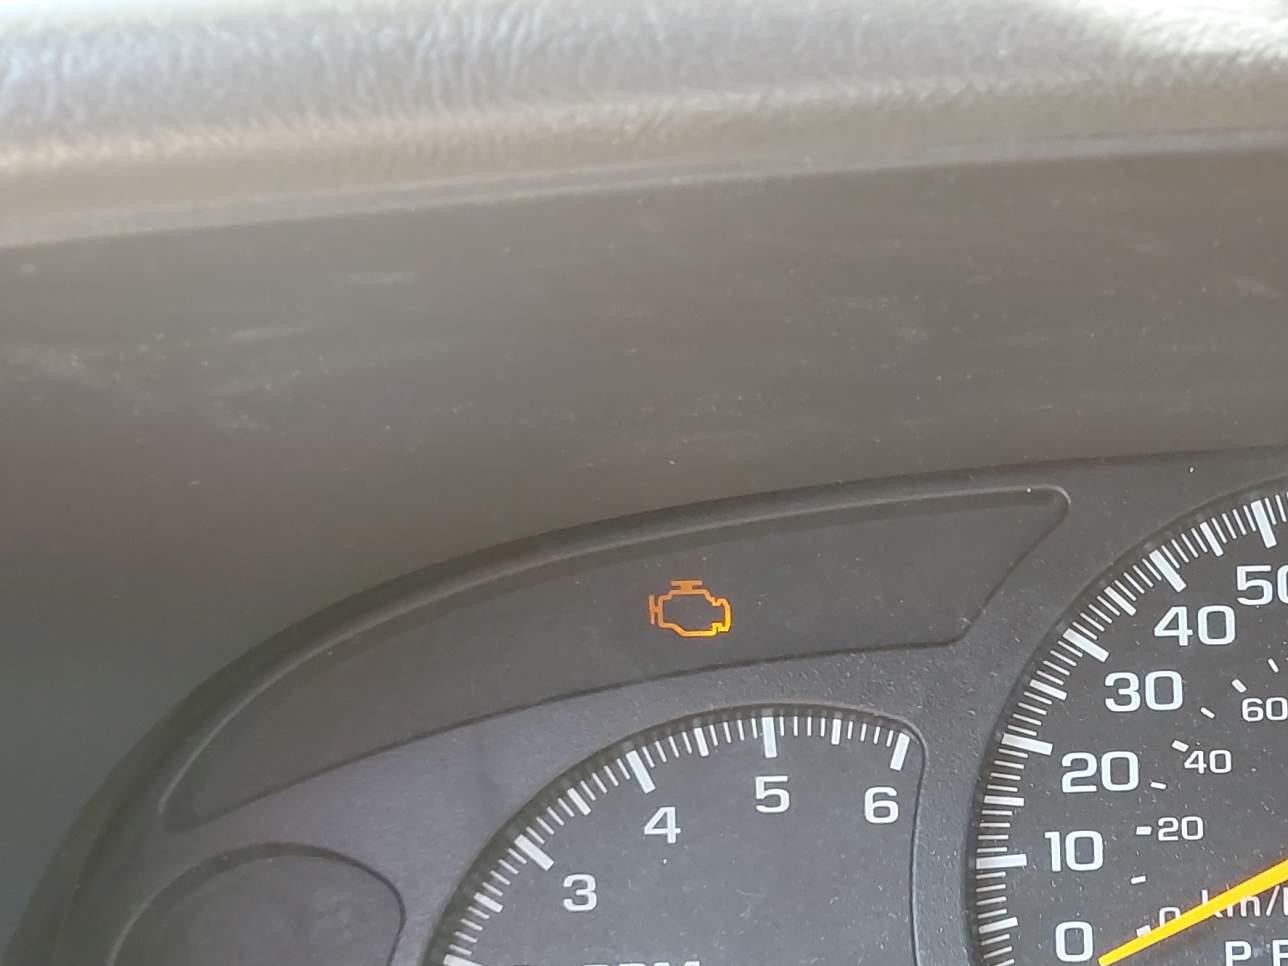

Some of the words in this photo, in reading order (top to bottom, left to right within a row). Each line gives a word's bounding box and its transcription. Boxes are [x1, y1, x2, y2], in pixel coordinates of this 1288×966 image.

[1154, 605, 1236, 646] 40
[1104, 670, 1183, 712] 30
[1241, 696, 1288, 722] 60
[1061, 751, 1139, 793] 20
[1184, 749, 1232, 774] 40
[755, 775, 790, 813] 5
[864, 786, 899, 824] 6
[643, 806, 682, 844] 4
[1157, 816, 1204, 841] 20
[1044, 830, 1104, 872] 10
[563, 874, 597, 912] 3
[1055, 921, 1094, 962] 0
